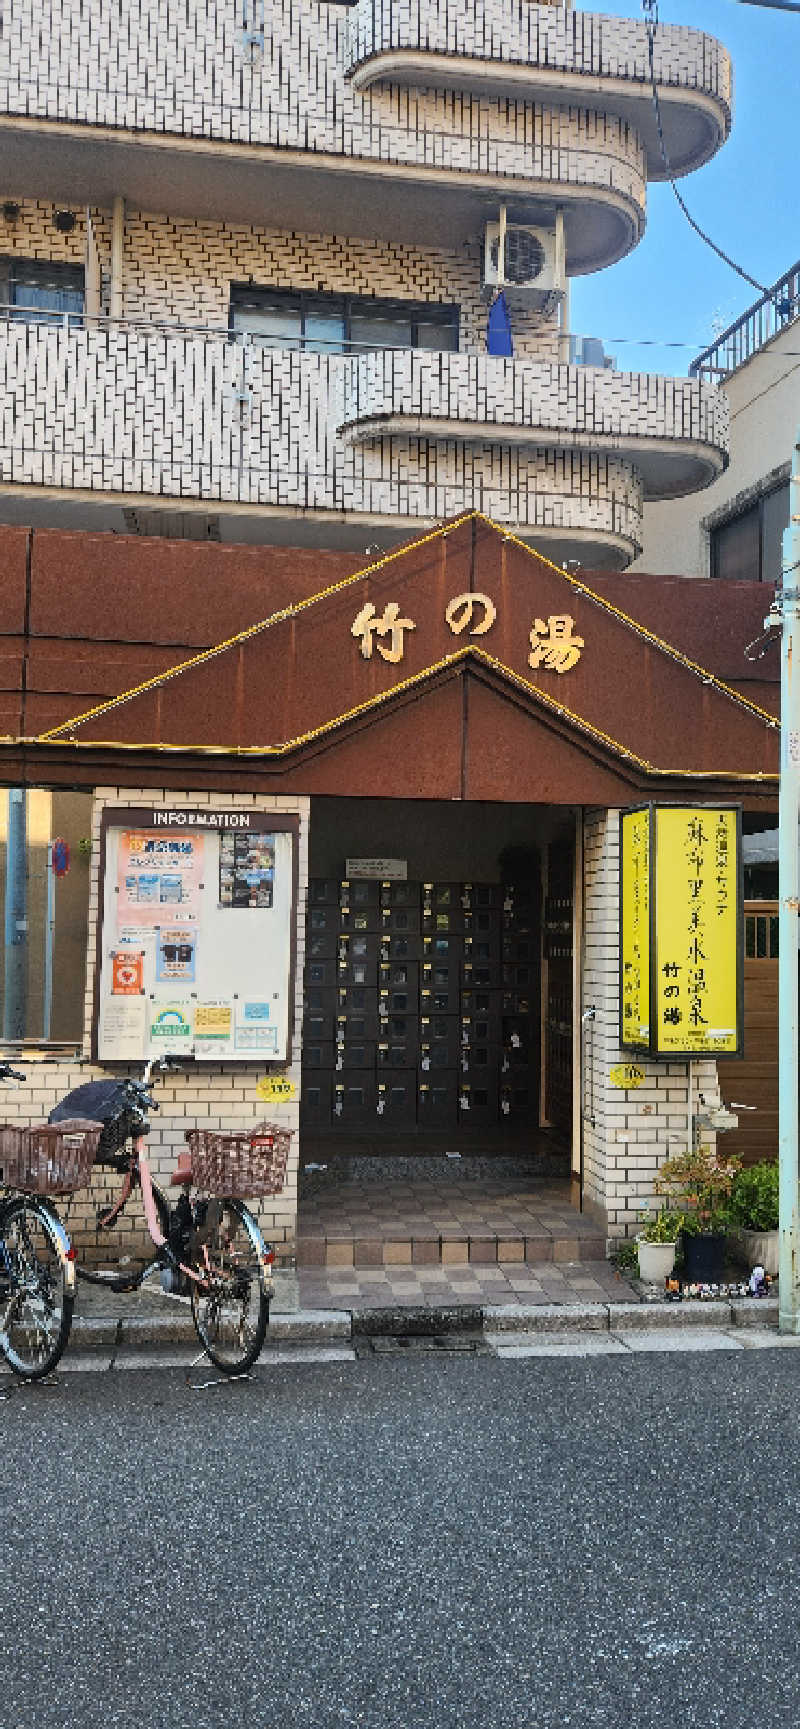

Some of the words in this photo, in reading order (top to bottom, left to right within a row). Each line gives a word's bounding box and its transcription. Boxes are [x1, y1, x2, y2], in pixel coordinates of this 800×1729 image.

[351, 592, 585, 674] 竹の湯
[153, 812, 250, 827] INFORMATION
[661, 962, 683, 1026] 竹の湯
